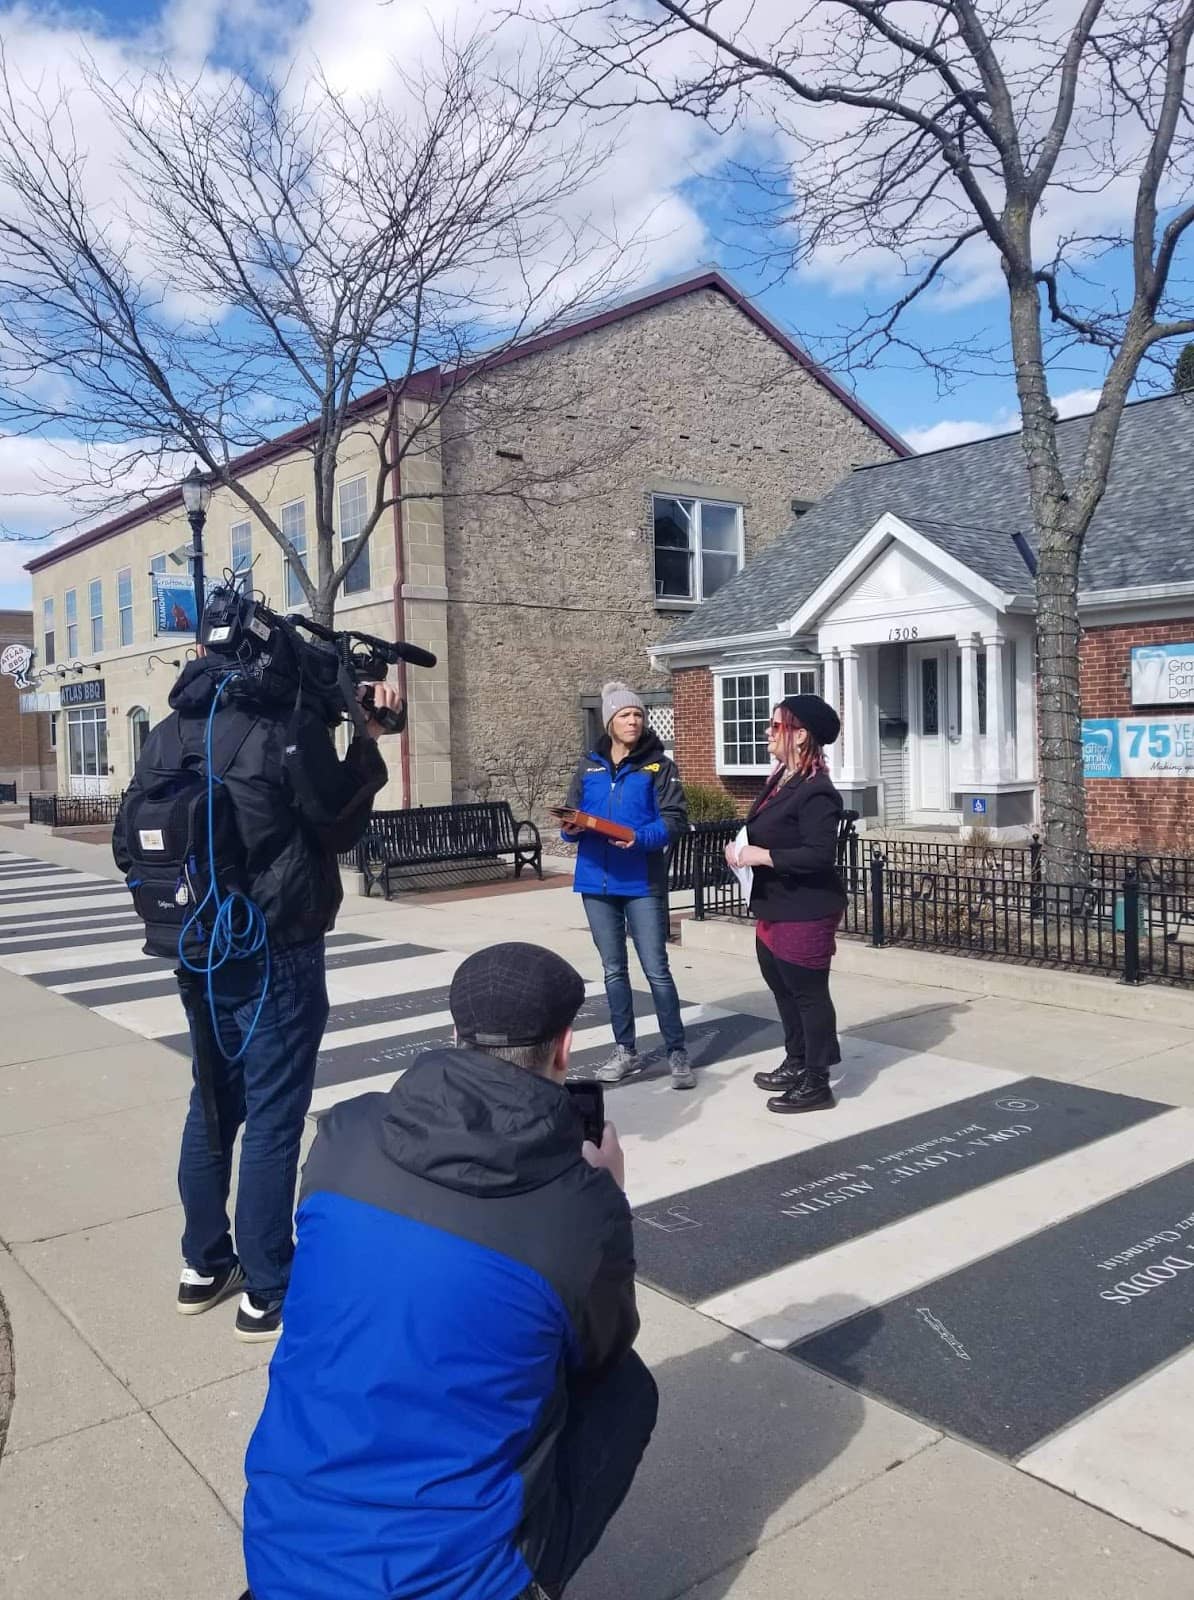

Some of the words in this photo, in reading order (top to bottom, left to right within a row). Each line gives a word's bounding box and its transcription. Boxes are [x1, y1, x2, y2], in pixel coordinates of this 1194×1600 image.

[888, 625, 919, 641] 1308
[2, 647, 24, 664] ATLAS
[8, 656, 24, 669] BBQ
[61, 684, 83, 704] ATLAS
[84, 681, 101, 700] BBQ
[1126, 724, 1171, 759] 75
[1174, 723, 1194, 741] YE
[967, 1123, 1033, 1147] CORA
[877, 1135, 958, 1165] Bandleader
[780, 1171, 858, 1198] Musician
[780, 1180, 875, 1219] AUSTIN
[1096, 1230, 1182, 1271] Clarinetist
[1099, 1255, 1194, 1305] DODDS
